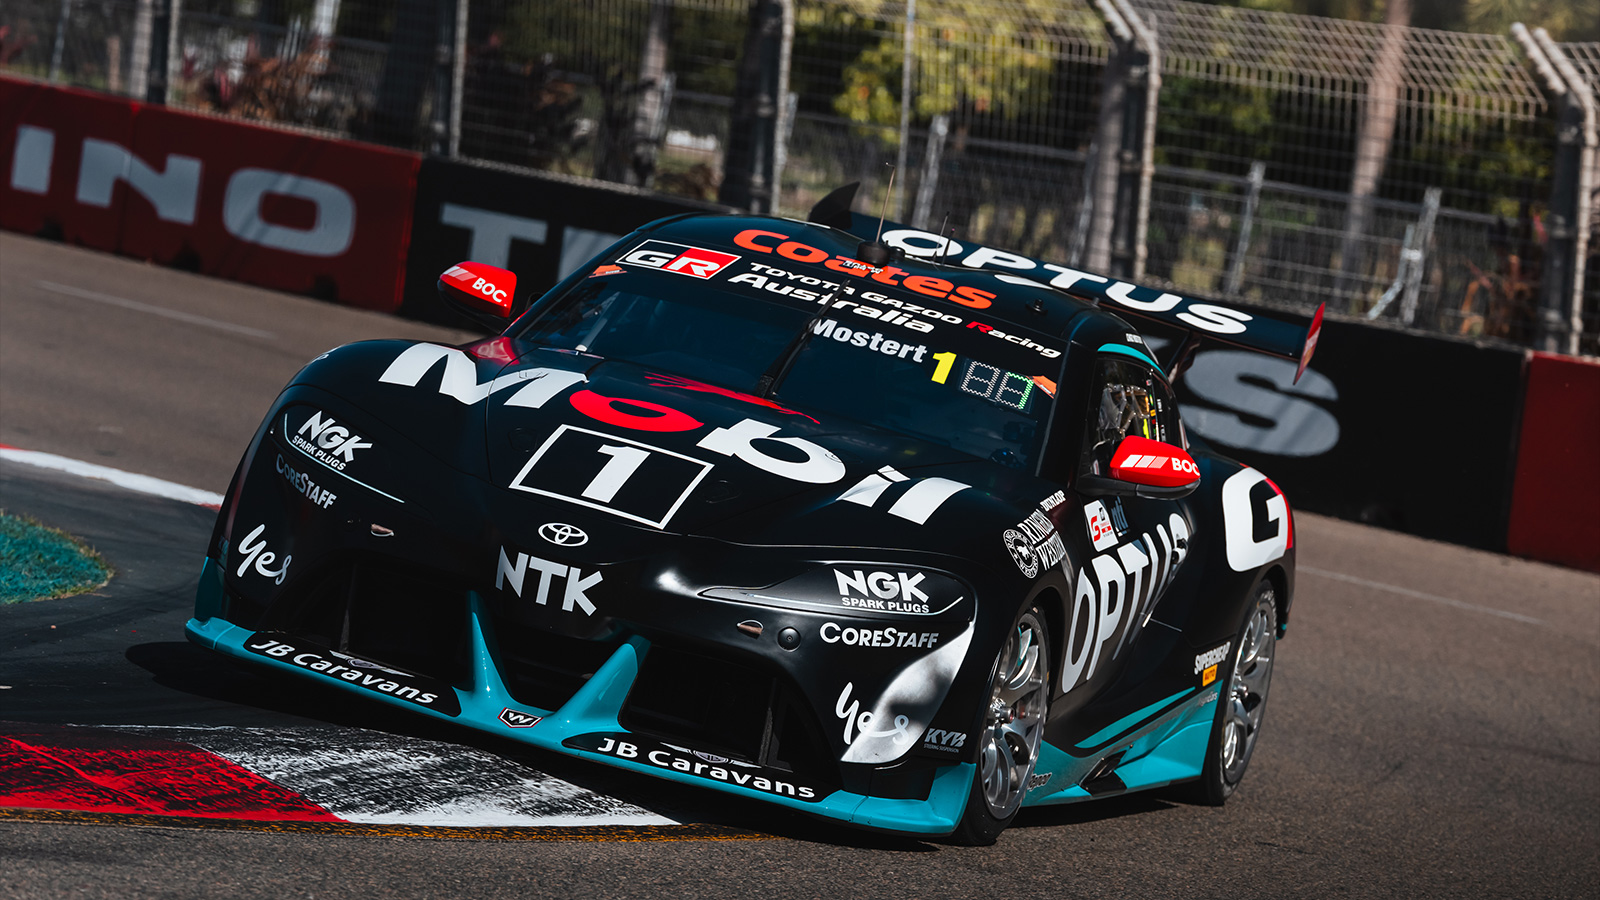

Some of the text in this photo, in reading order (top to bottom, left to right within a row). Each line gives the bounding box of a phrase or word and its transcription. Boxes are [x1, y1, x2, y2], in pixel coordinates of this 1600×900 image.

[472, 277, 507, 303] BOC
[625, 250, 721, 277] GR
[733, 229, 997, 309] Coates
[882, 229, 1253, 334] OPTUS
[727, 273, 935, 334] Australia
[750, 262, 856, 295] TOYOTA
[860, 291, 963, 325] GAZOO
[966, 320, 1061, 359] Racing
[812, 319, 957, 385] Mostert 1
[292, 434, 347, 471] SPARK PLUGS
[297, 410, 373, 463] NGK
[378, 342, 972, 525] Mobil
[581, 441, 652, 503] 1
[1171, 457, 1200, 476] BOC
[1039, 489, 1066, 512] DUNLOP
[237, 523, 292, 585] Yes
[495, 545, 603, 616] NTK
[833, 568, 929, 603] NGK
[842, 597, 929, 613] SPARK PLUGS
[251, 640, 439, 704] JB Caravans
[597, 737, 815, 798] JB Caravans
[924, 728, 967, 748] KYB
